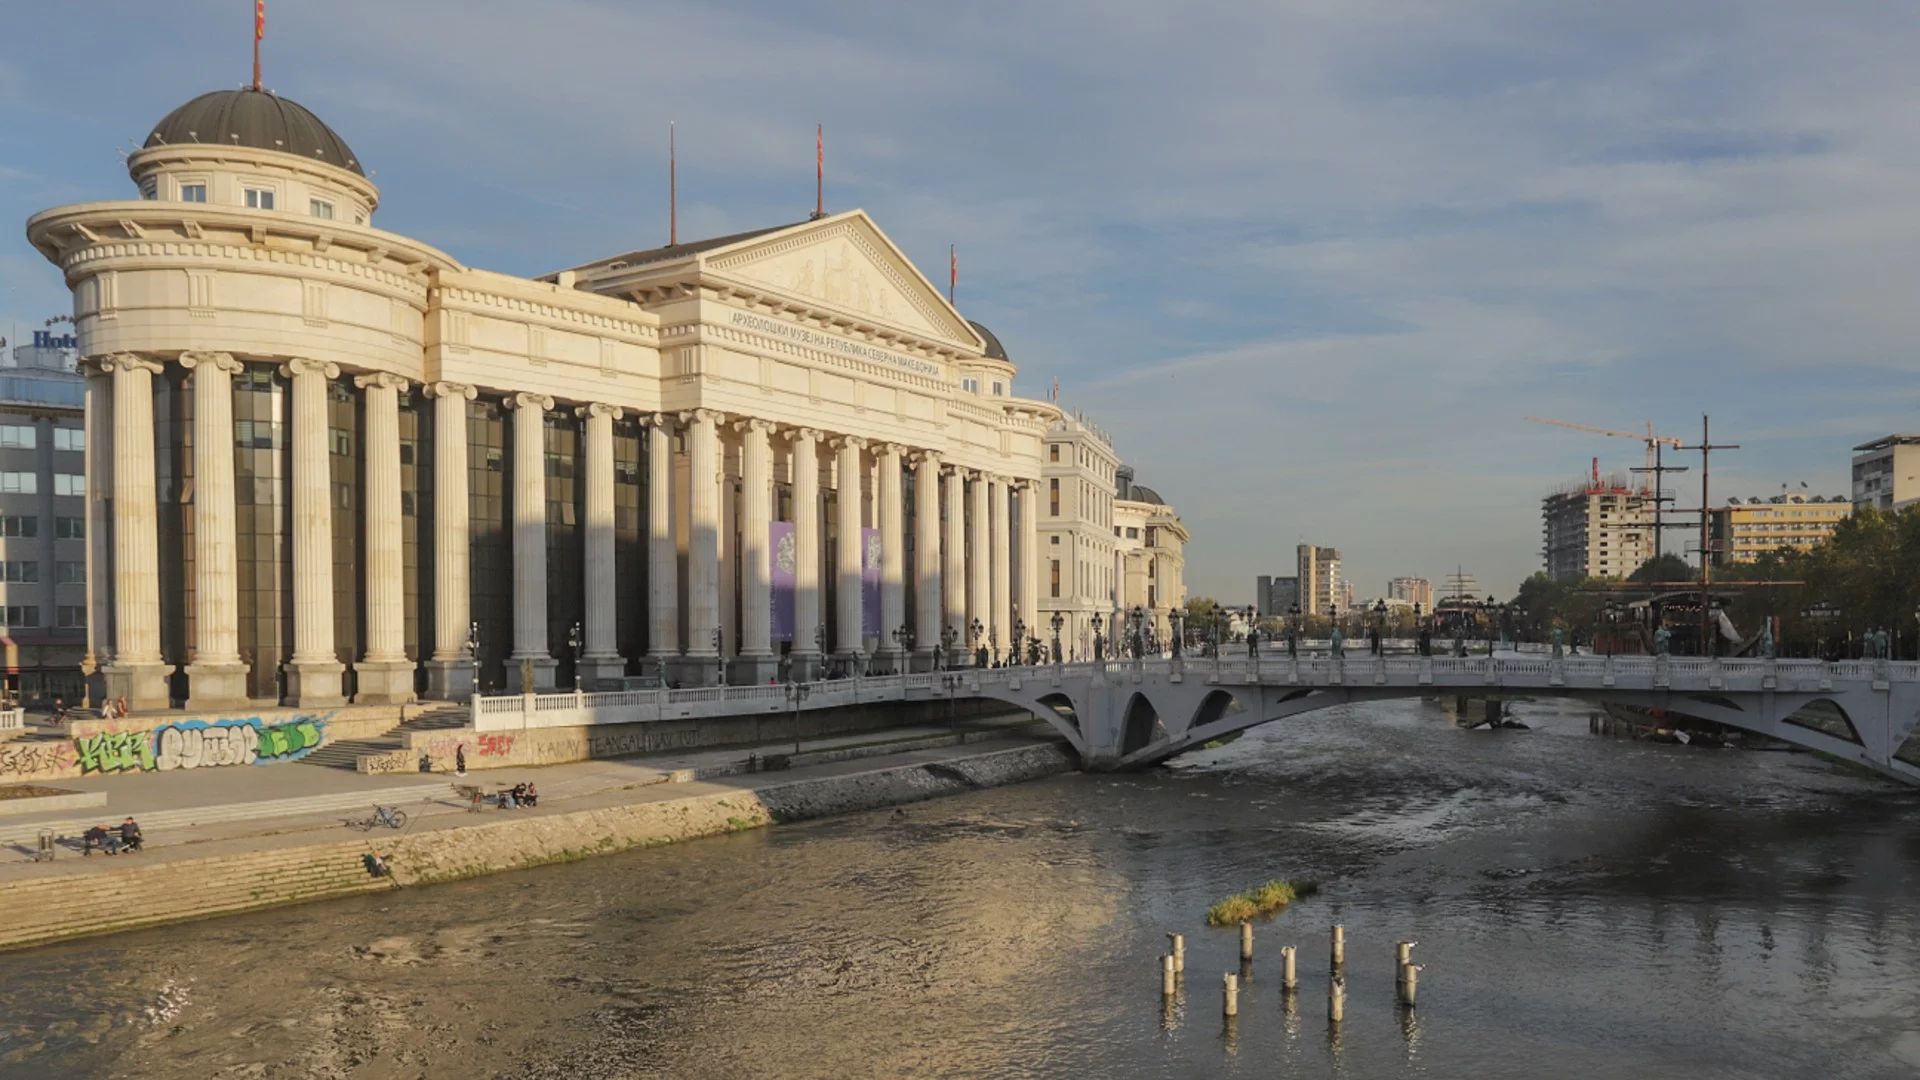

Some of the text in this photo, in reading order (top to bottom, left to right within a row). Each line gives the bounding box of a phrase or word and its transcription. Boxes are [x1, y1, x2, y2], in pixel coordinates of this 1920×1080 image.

[732, 312, 940, 376] АРХЕОЛОШКИ МУЗЕЈ НА РЕПУБЛИКА СЕВЕРНА МАКЕДОНИЈА
